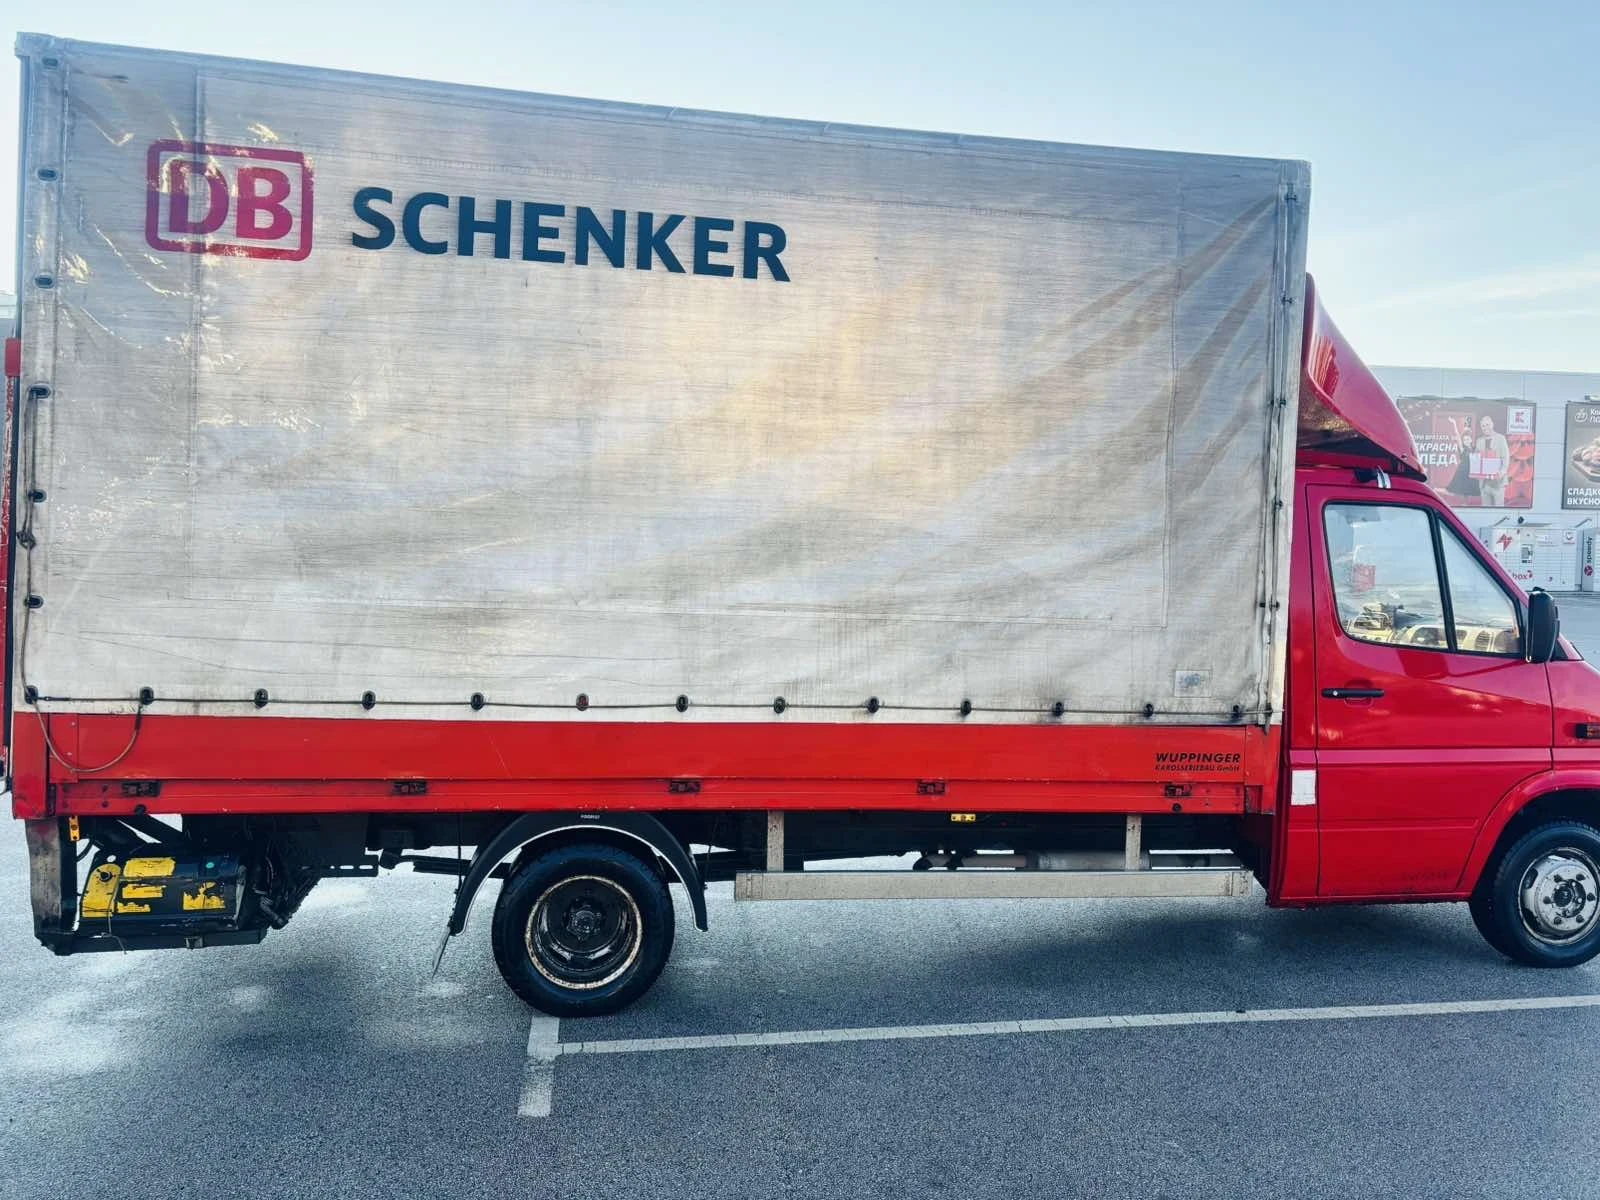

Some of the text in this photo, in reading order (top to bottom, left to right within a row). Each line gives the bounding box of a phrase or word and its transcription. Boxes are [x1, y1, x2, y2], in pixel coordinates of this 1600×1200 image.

[167, 158, 792, 283] DB SCHENKER
[1156, 753, 1241, 763] WUPPINGER
